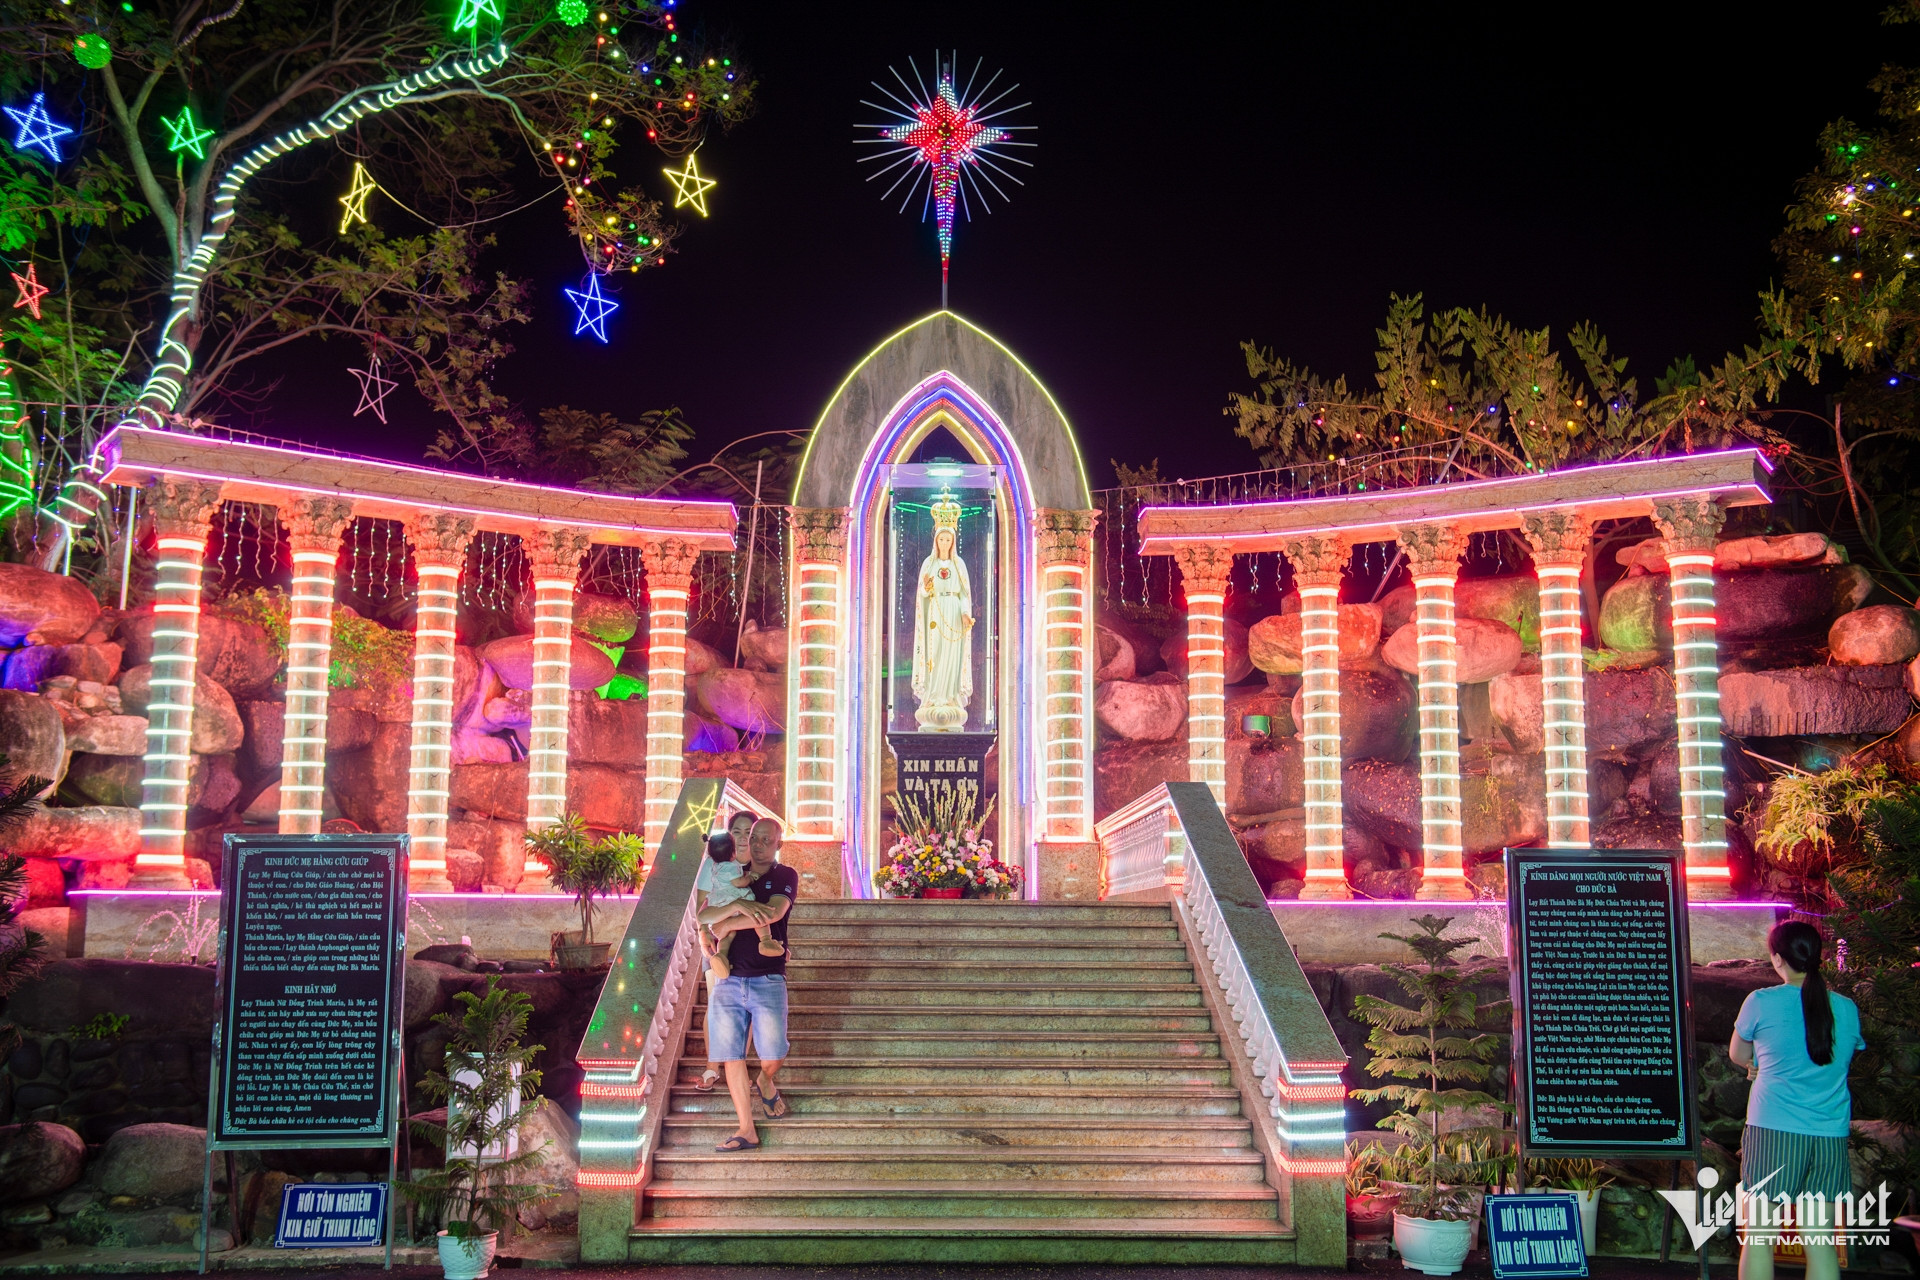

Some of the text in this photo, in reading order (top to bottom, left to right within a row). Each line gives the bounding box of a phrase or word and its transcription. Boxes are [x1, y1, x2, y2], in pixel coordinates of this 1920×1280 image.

[903, 757, 978, 772] XIN KHẤN
[904, 776, 924, 791] VÀ
[264, 854, 368, 866] KINH ĐỨC MẸ HẰNG CỨU GIÚP
[1530, 870, 1661, 882] KÍNH DÂNG MỌI NGƯỜI NƯỚC VIỆT NAM
[1575, 883, 1616, 893] CHO ĐỨC BÀ
[284, 983, 336, 993] KINH HÃY NHỚ
[296, 1190, 372, 1212] NƠI TÔN NGHIÊM
[1500, 1203, 1568, 1232] NƠI TÔN NGHIÊM
[284, 1216, 376, 1240] XIN GIỮ THINH LẶNG
[1497, 1236, 1580, 1268] XIN GIỮ THINH LẶNG
